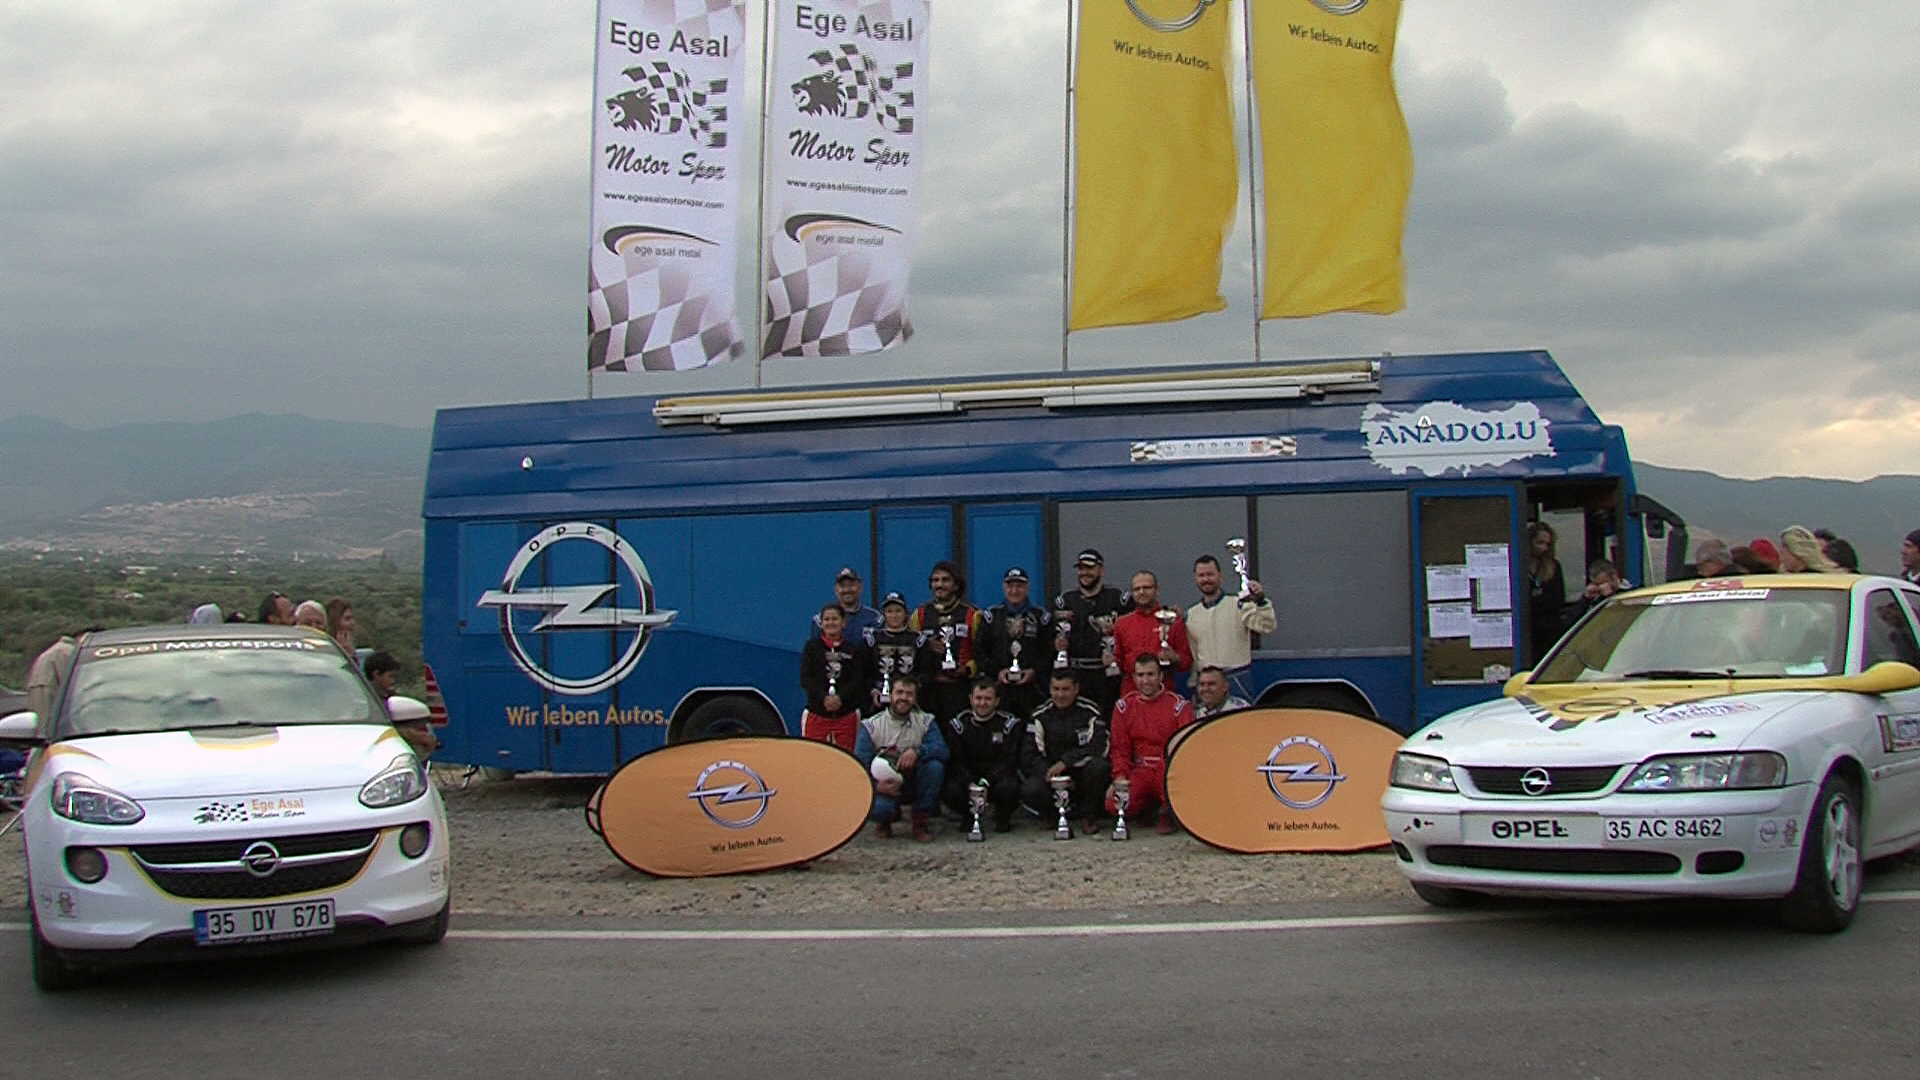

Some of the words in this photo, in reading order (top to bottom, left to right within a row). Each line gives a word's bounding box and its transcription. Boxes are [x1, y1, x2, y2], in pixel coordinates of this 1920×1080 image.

[796, 5, 847, 38] Ege
[854, 13, 913, 42] Asal
[1287, 23, 1307, 38] Wir
[1310, 27, 1343, 47] leben
[609, 20, 661, 54] Ege
[669, 29, 728, 58] Asal
[1113, 39, 1133, 55] Wir
[1137, 44, 1172, 63] leben
[789, 129, 855, 161] Motor
[863, 137, 910, 172] Spor
[605, 143, 670, 176] Motor
[678, 151, 726, 185] Spor
[634, 245, 652, 257] ege
[655, 246, 675, 257] asal
[815, 233, 834, 246] ege
[1375, 420, 1537, 445] ANADOLU
[528, 526, 622, 552] OPEL
[94, 643, 158, 657] Opel
[165, 640, 315, 651] Motorsports
[506, 703, 538, 726] Wir
[543, 703, 599, 725] leben
[604, 703, 670, 725] Autos.
[250, 798, 275, 812] Ege
[278, 798, 304, 810] Asal
[1283, 820, 1309, 831] leben
[1608, 820, 1631, 839] 35
[1638, 819, 1668, 838] AC
[1674, 818, 1722, 837] 8462
[728, 840, 755, 851] leben
[210, 912, 235, 935] 35
[252, 909, 276, 932] DV
[293, 903, 330, 928] 678
